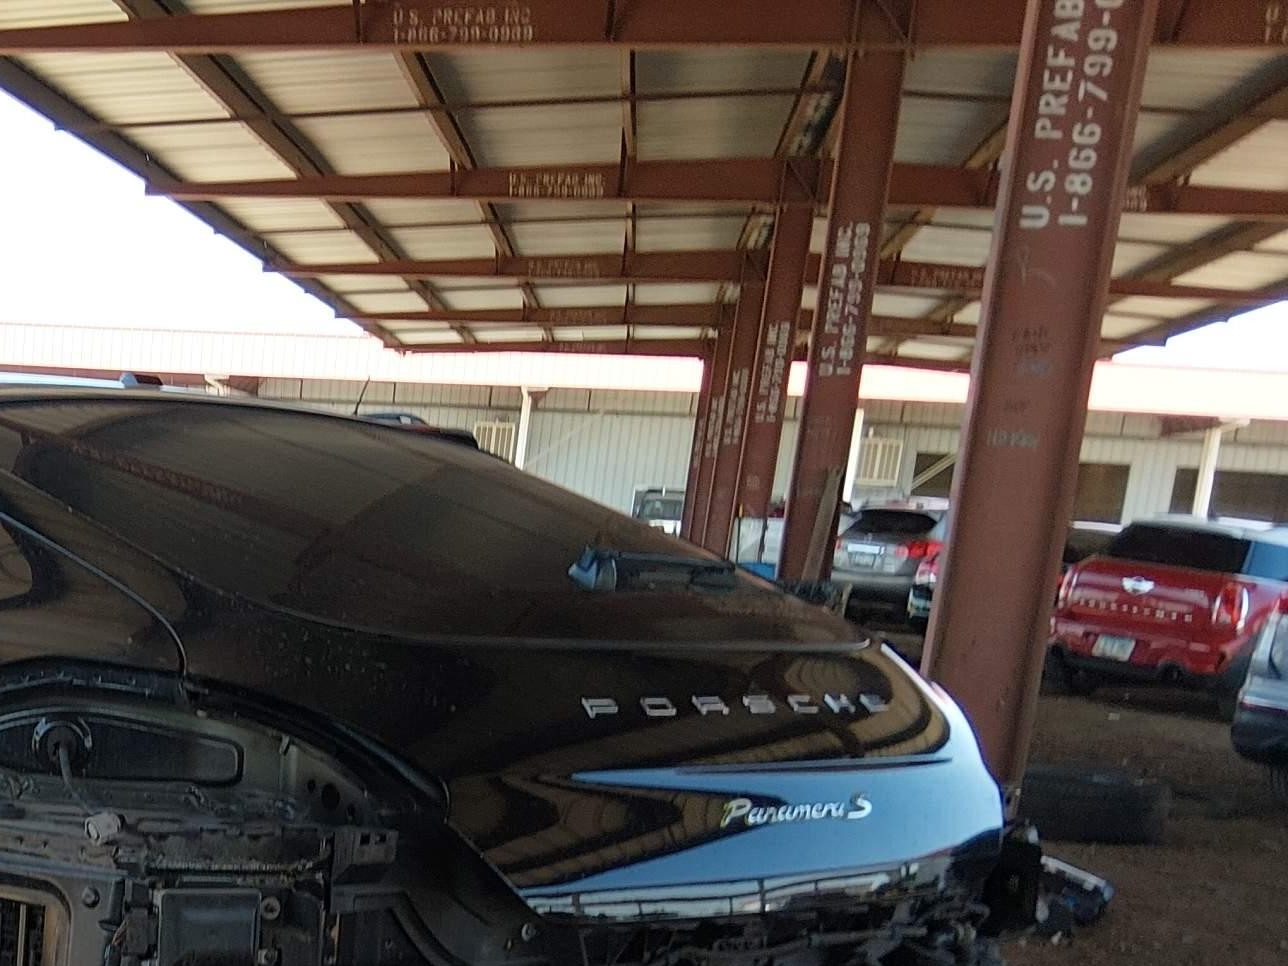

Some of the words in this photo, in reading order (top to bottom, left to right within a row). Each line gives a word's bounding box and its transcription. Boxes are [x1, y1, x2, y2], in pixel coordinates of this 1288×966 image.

[1034, 0, 1085, 139] PREFAB
[1019, 159, 1059, 229] U.S.
[824, 263, 847, 334] PREFAB
[581, 693, 889, 718] PORSCHE
[720, 798, 844, 828] Panamera
[847, 796, 873, 819] S
